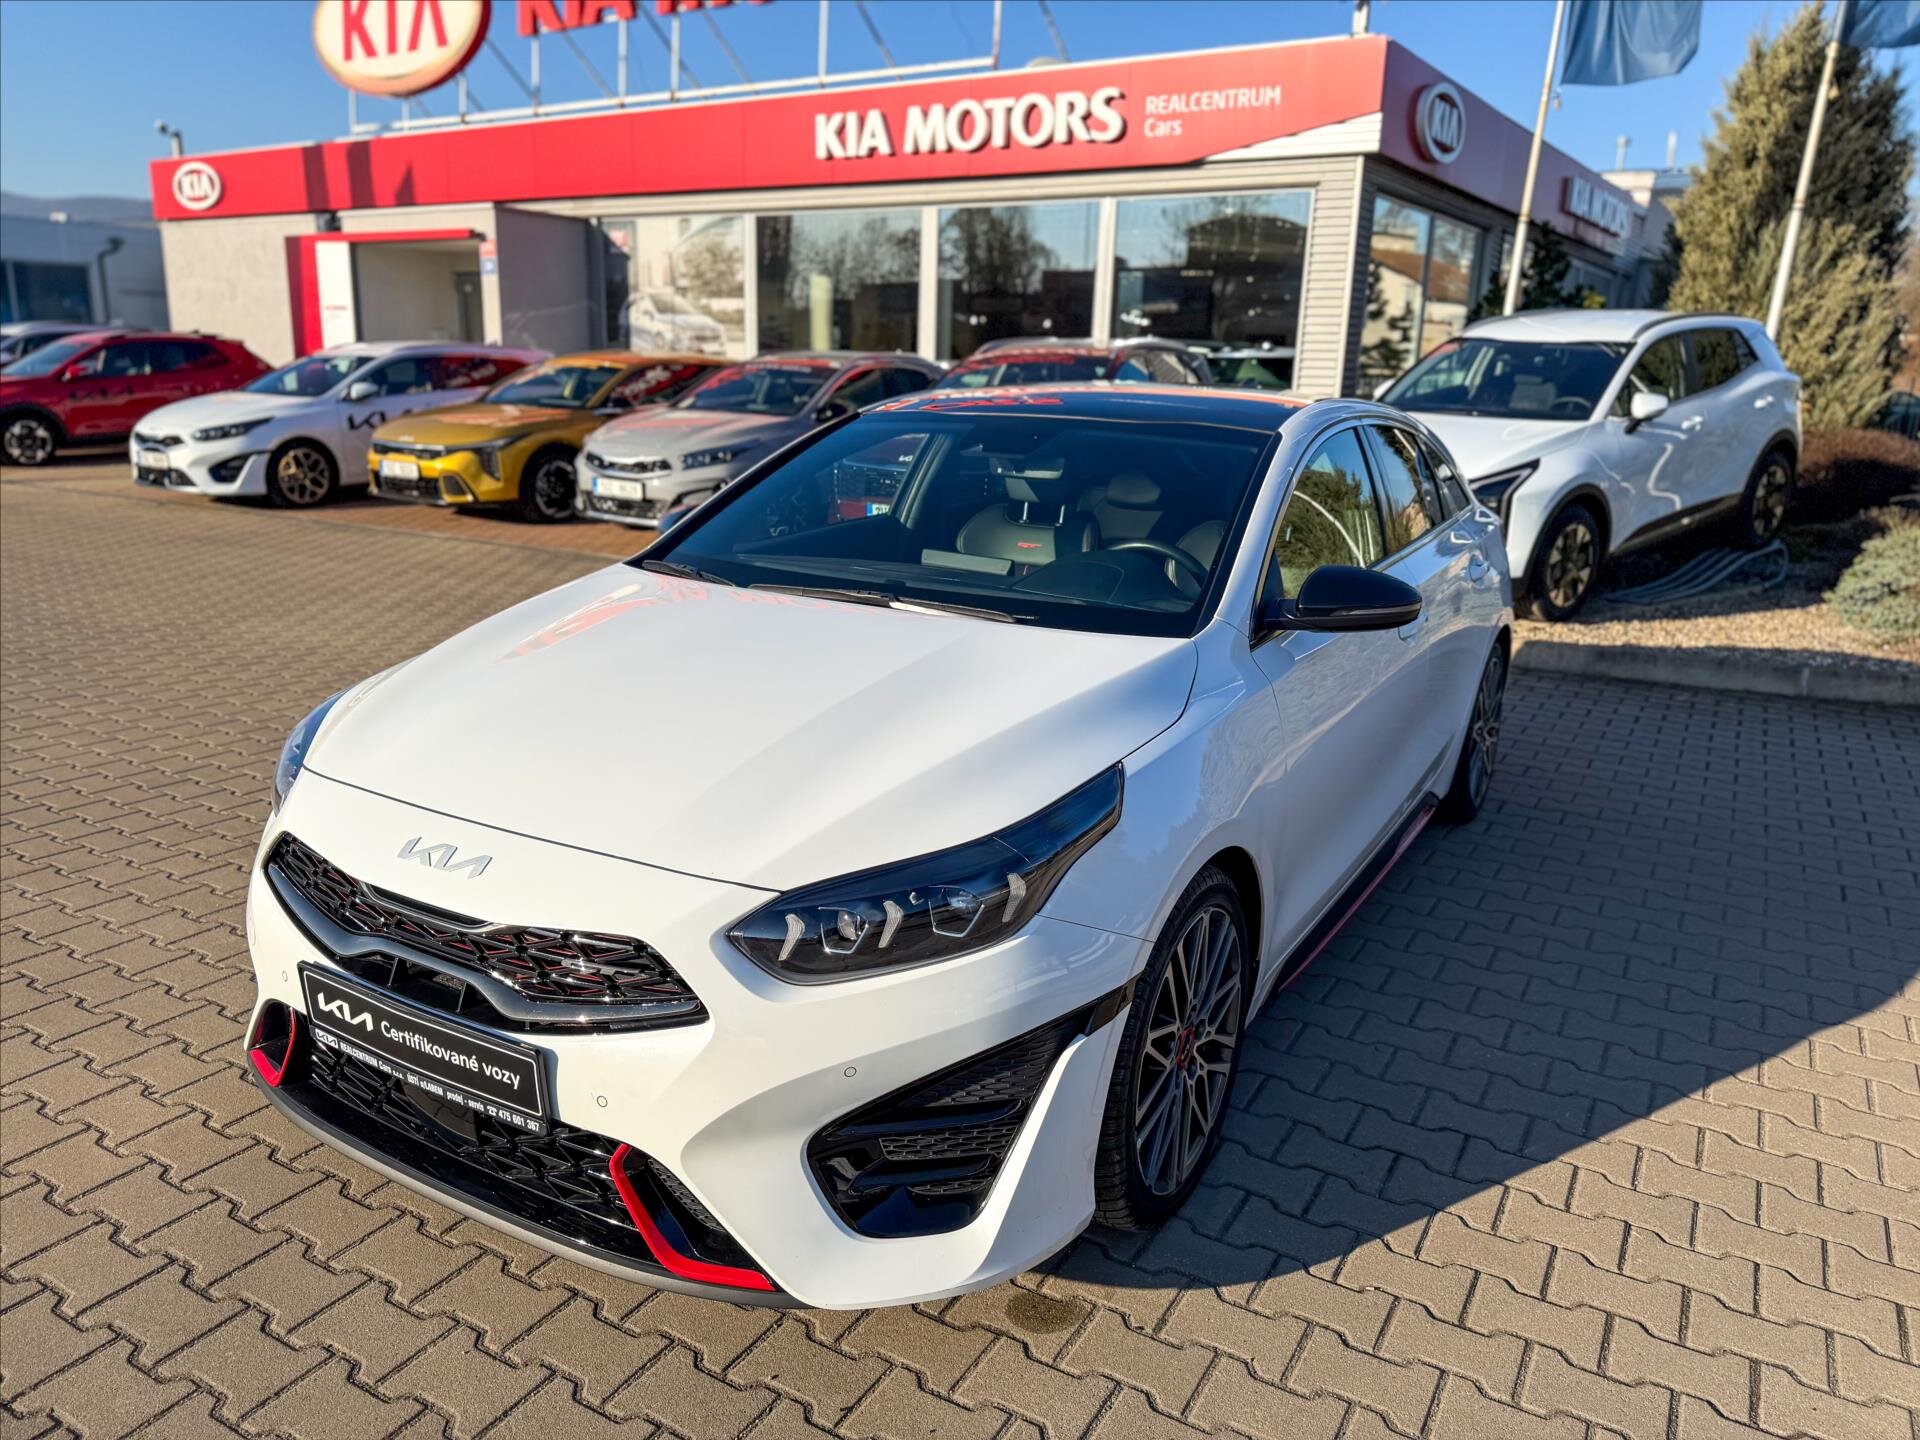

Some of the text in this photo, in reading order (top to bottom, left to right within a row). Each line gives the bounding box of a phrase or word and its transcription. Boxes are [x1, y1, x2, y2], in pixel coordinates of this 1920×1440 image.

[343, 0, 448, 61] KIA
[815, 86, 1124, 160] KIA MOTORS
[1144, 86, 1282, 116] REALCENTRUM
[1431, 96, 1459, 149] KIA
[1144, 117, 1183, 138] Cars
[181, 172, 212, 198] KIA
[397, 836, 493, 880] KIA
[316, 1031, 337, 1047] KIA
[340, 1041, 379, 1068] REALCENTRUM
[379, 1061, 392, 1075] Cars
[317, 992, 521, 1090] KIA Certifikované vozy
